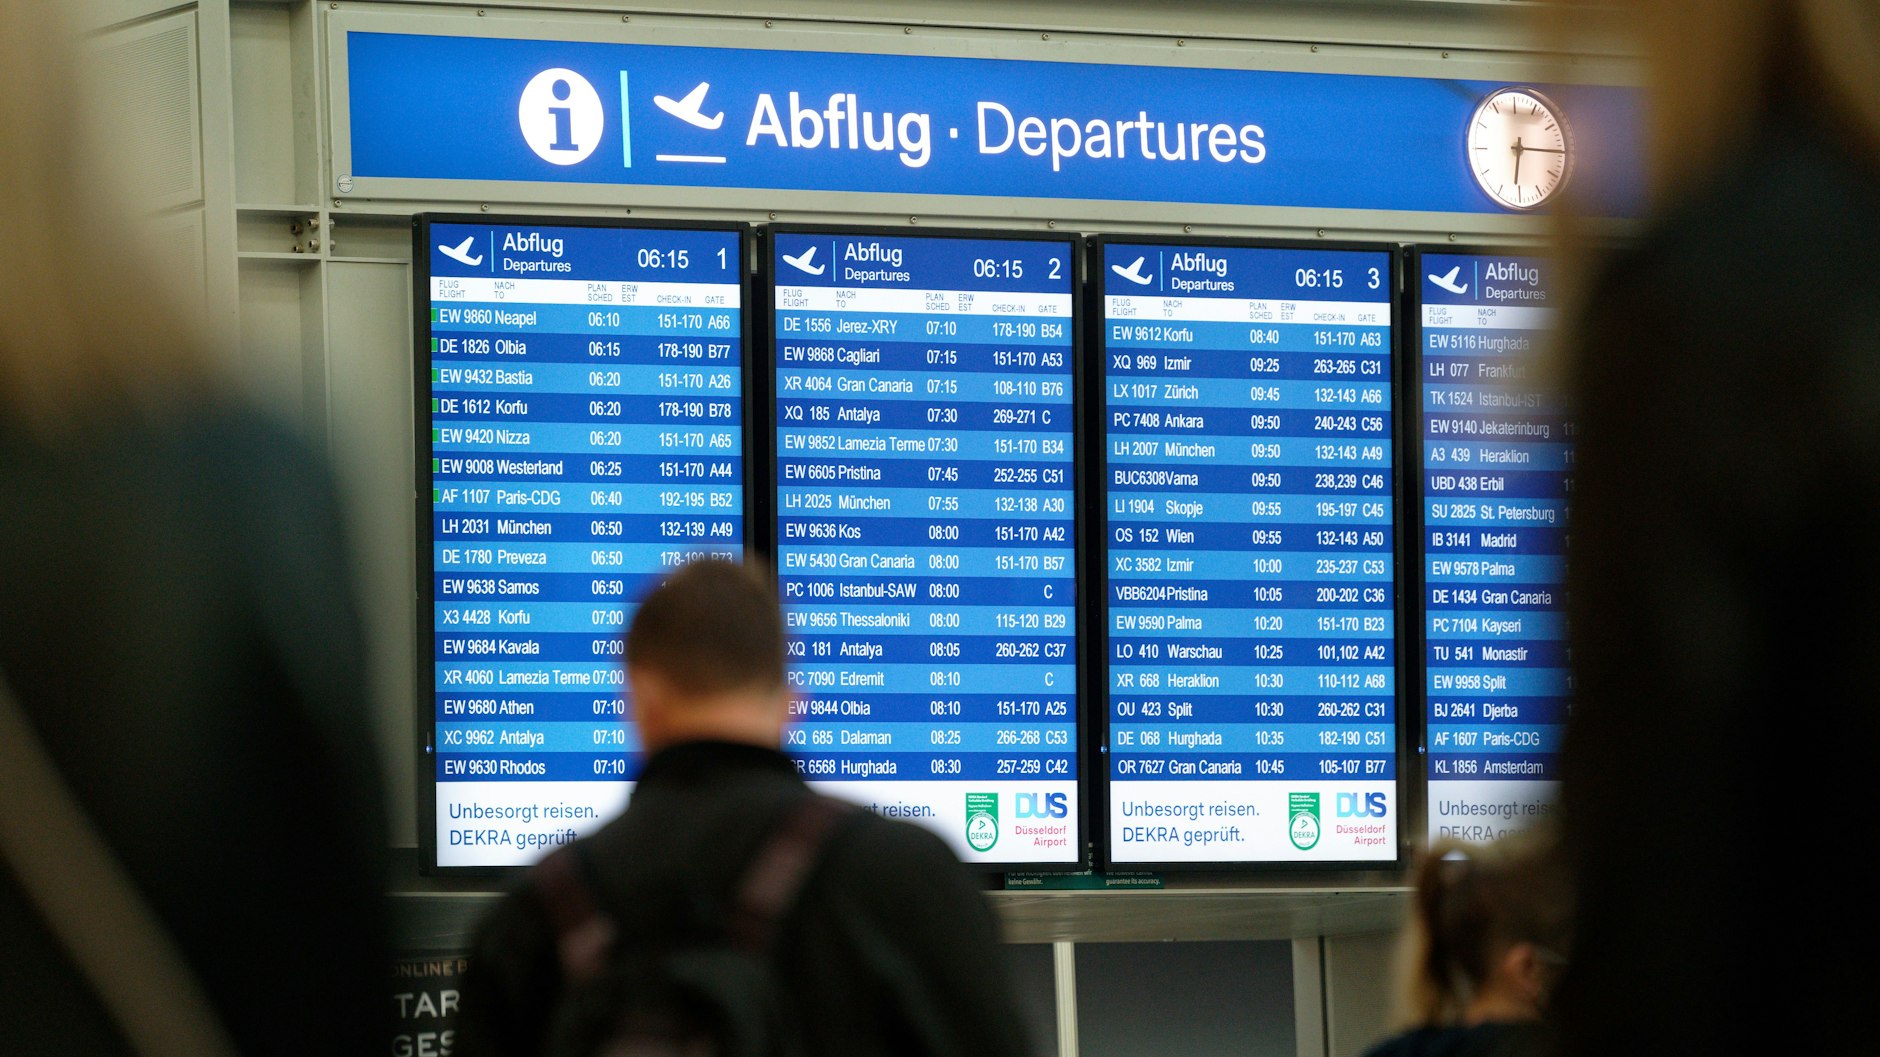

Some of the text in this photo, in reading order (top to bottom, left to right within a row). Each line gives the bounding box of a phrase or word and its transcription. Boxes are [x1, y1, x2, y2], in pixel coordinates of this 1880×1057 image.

[746, 92, 1266, 171] Abflug Departures
[503, 233, 563, 257] Abflug
[844, 243, 902, 266] Abflug
[504, 258, 571, 274] Departures
[638, 248, 726, 269] 06:15 1
[1171, 253, 1227, 276] Abflug
[845, 268, 910, 283] Departures
[974, 258, 1060, 279] 06:15 2
[1485, 262, 1538, 285] Abflug
[439, 281, 638, 293] FLUG NACH PLAN ERW
[1172, 278, 1234, 293] Departures
[1295, 268, 1380, 289] 06:15 3
[439, 290, 725, 304] FLIGHT TO SCHED EST CHECK-IN GATE
[1486, 287, 1545, 301] Departures
[439, 308, 730, 330] EW 9860 Neapel 06:10 151-170 A66
[1429, 307, 1446, 315] FLUG
[1429, 316, 1452, 324] FLIGHT
[783, 316, 1062, 338] DE 1556 Jerez-XRY 07:10 178-190 B54
[1113, 354, 1380, 375] XQ 969 Izmir 09:25 263-265 C31
[440, 368, 731, 388] EW 9432 Bastia 06:20 151-170 A26
[784, 375, 1063, 396] XR 4064 Gran Canaria 07:15 108-110 B76
[1113, 383, 1382, 403] LX 1017 Zürich 09:45 132-143 A66
[784, 405, 1051, 424] XQ 185 Antalya 07:30 269-271 C
[1430, 418, 1549, 438] EW 9140 Jekaterinburg
[441, 458, 732, 477] EW 9008 Westerland 06:25 151-170 A44
[785, 493, 1064, 512] LH 2025 München 07:55 132-138 A30
[1431, 503, 1555, 523] SU 2825 St. Petersburg
[442, 518, 733, 536] LH 2031 München 06:50 132-139 A49
[1115, 527, 1384, 546] OS 152 Wien 09:55 132-143 A50
[1432, 588, 1552, 604] DE 1434 Gran Canaria
[442, 609, 623, 625] X3 4428 Korfu 07:00
[1116, 643, 1385, 661] LO 410 Warschau 10:25 101,102 A42
[1434, 731, 1540, 746] AF 1607 Paris-CDG
[450, 802, 599, 823] Unbesorgt reisen.
[883, 801, 935, 817] reisen.
[1016, 793, 1067, 818] DUS
[1123, 801, 1259, 819] Unbesorgt reisen.
[1337, 793, 1386, 817] DUS
[1440, 801, 1518, 819] Unbesorgt
[450, 830, 511, 845] DEKRA
[971, 832, 993, 840] DEKRA
[1016, 826, 1066, 834] Düsseldorf
[1123, 826, 1244, 846] DEKRA geprüft.
[1337, 825, 1385, 834] Düsseldorf
[1440, 826, 1493, 840] DEKRA
[1034, 838, 1066, 848] Airport
[1354, 836, 1385, 846] Airport
